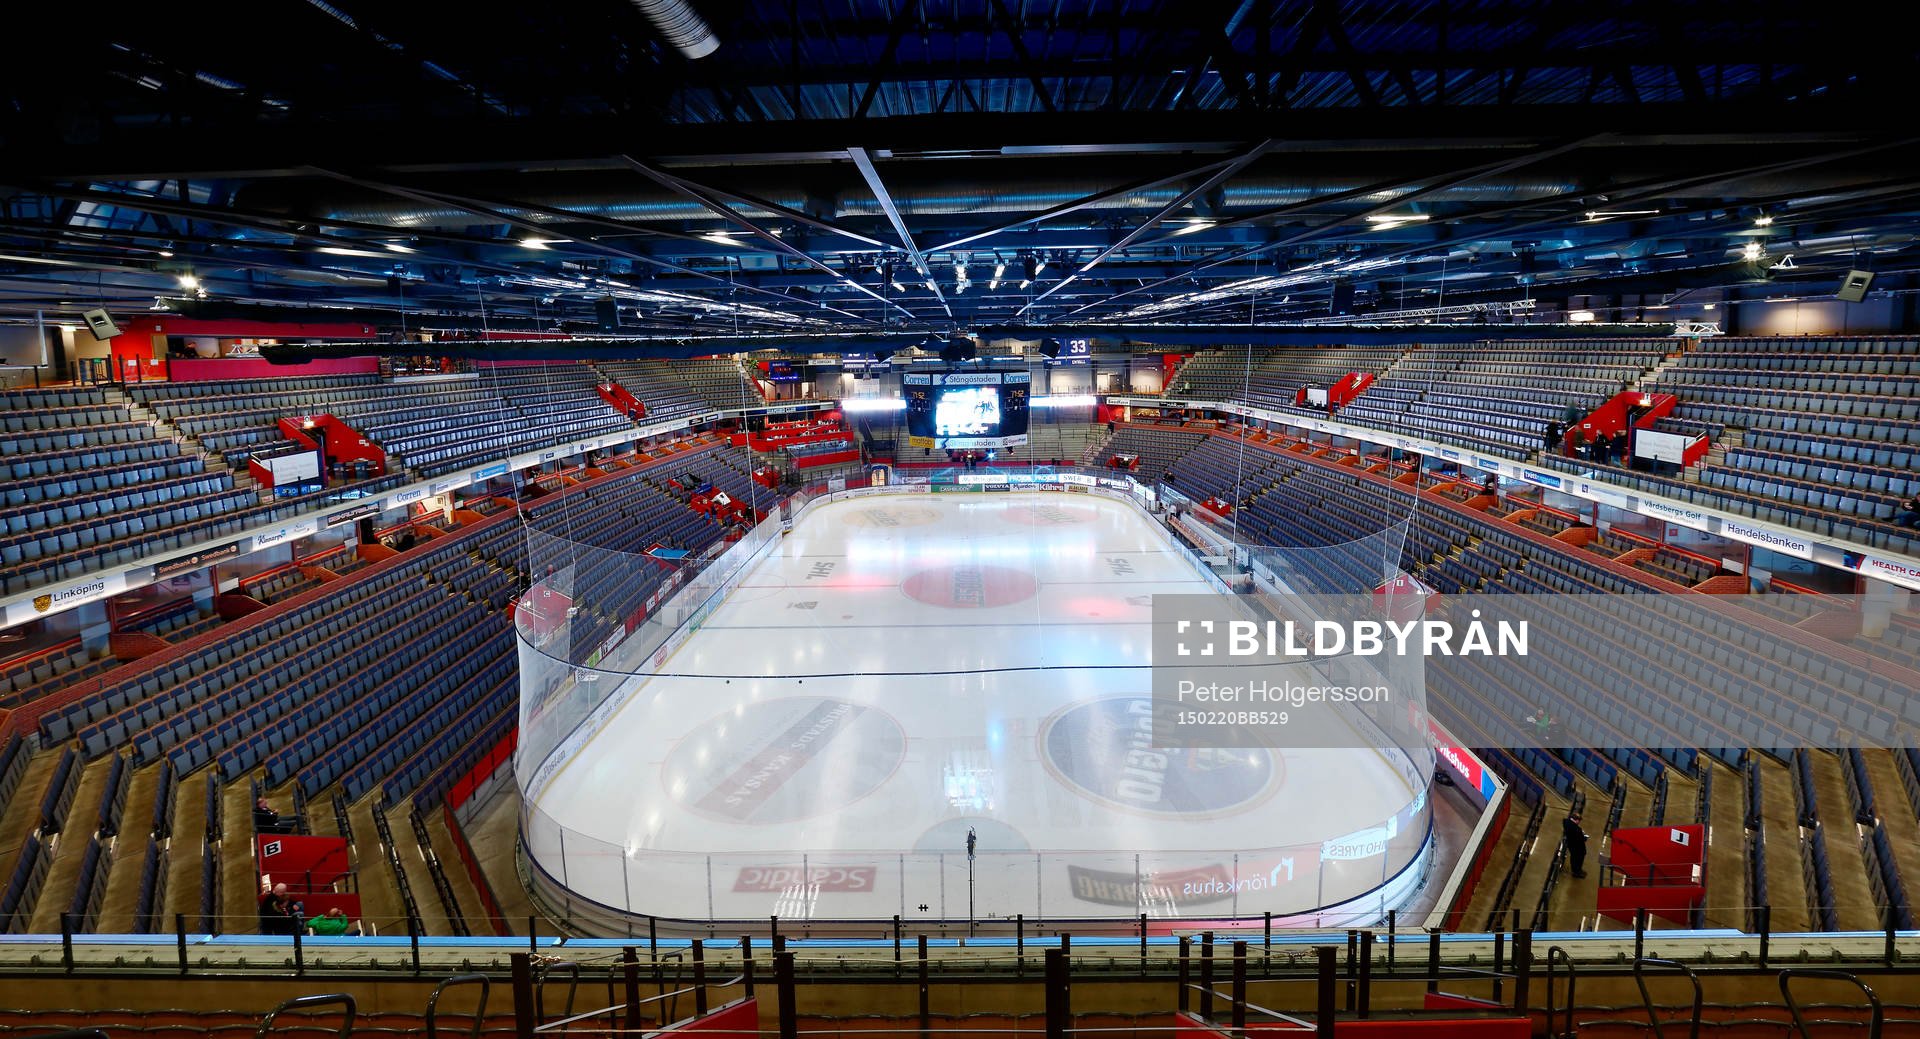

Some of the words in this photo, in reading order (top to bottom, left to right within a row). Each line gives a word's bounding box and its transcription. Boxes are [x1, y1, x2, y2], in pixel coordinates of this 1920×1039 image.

[1070, 340, 1086, 353] 33
[904, 375, 930, 385] Corren
[949, 374, 997, 384] Stångåstaden
[1004, 374, 1029, 384] Corren
[949, 438, 996, 447] Sstaden
[396, 489, 421, 503] Corren
[1644, 499, 1683, 516] Vårdsbergs
[1685, 510, 1701, 520] Golf
[1727, 523, 1805, 551] Handelsbanken
[159, 559, 191, 574] Swedbank
[201, 548, 230, 561] Swedbank
[1872, 559, 1906, 574] HEALTH
[53, 581, 104, 602] Linköping
[726, 754, 793, 808] KANSAS
[265, 842, 279, 856] B
[742, 866, 868, 888] Scandic
